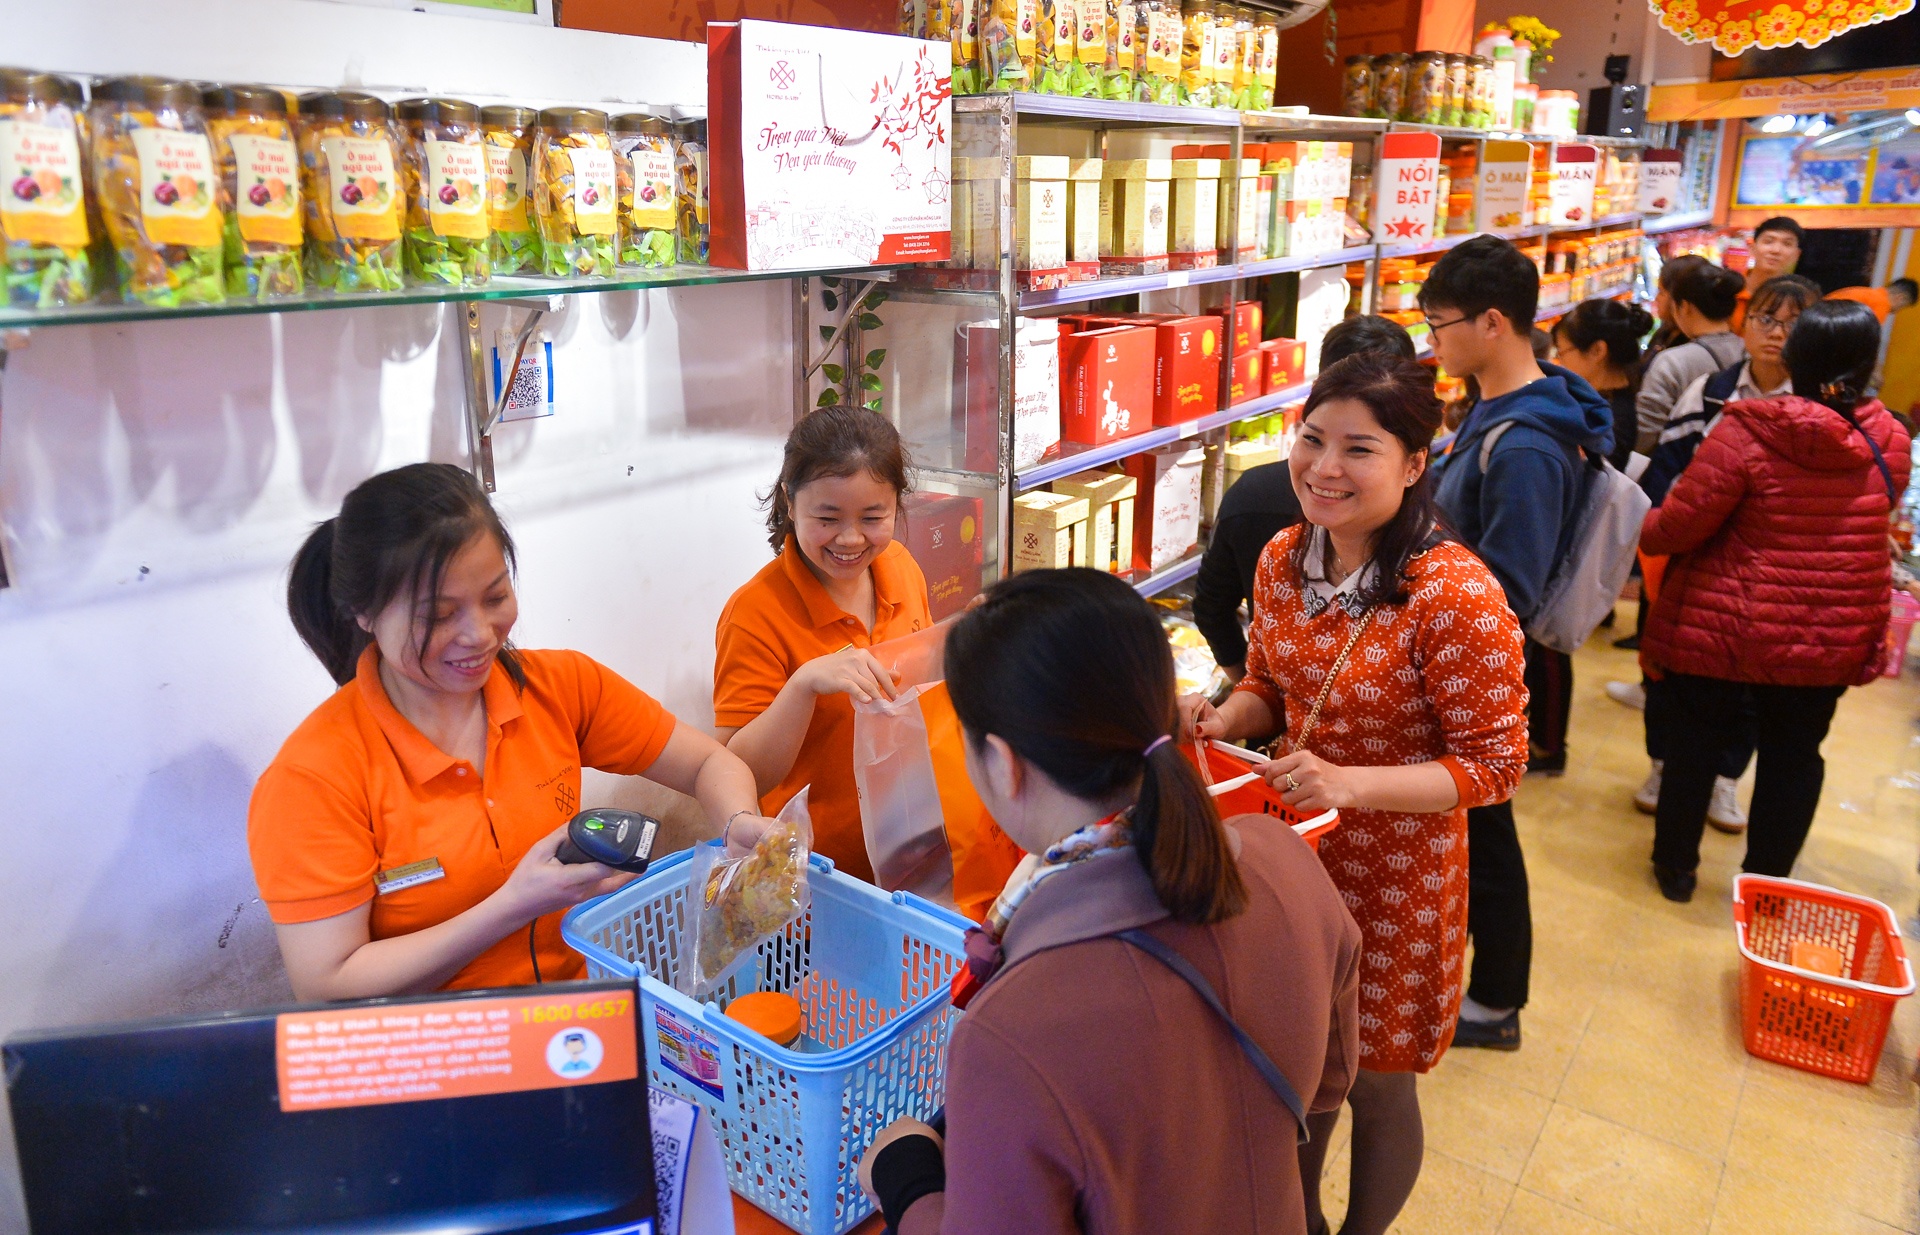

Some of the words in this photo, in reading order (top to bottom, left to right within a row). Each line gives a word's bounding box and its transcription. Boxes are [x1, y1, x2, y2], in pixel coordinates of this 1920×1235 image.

[757, 121, 792, 151] Trọn
[793, 126, 818, 149] quà
[818, 125, 848, 149] Việt
[1399, 159, 1433, 182] NỔI
[1485, 170, 1497, 183] Ô
[1501, 170, 1528, 183] MAI
[1396, 185, 1432, 209] BẬT
[521, 1003, 573, 1024] 1800
[577, 998, 629, 1020] 6657
